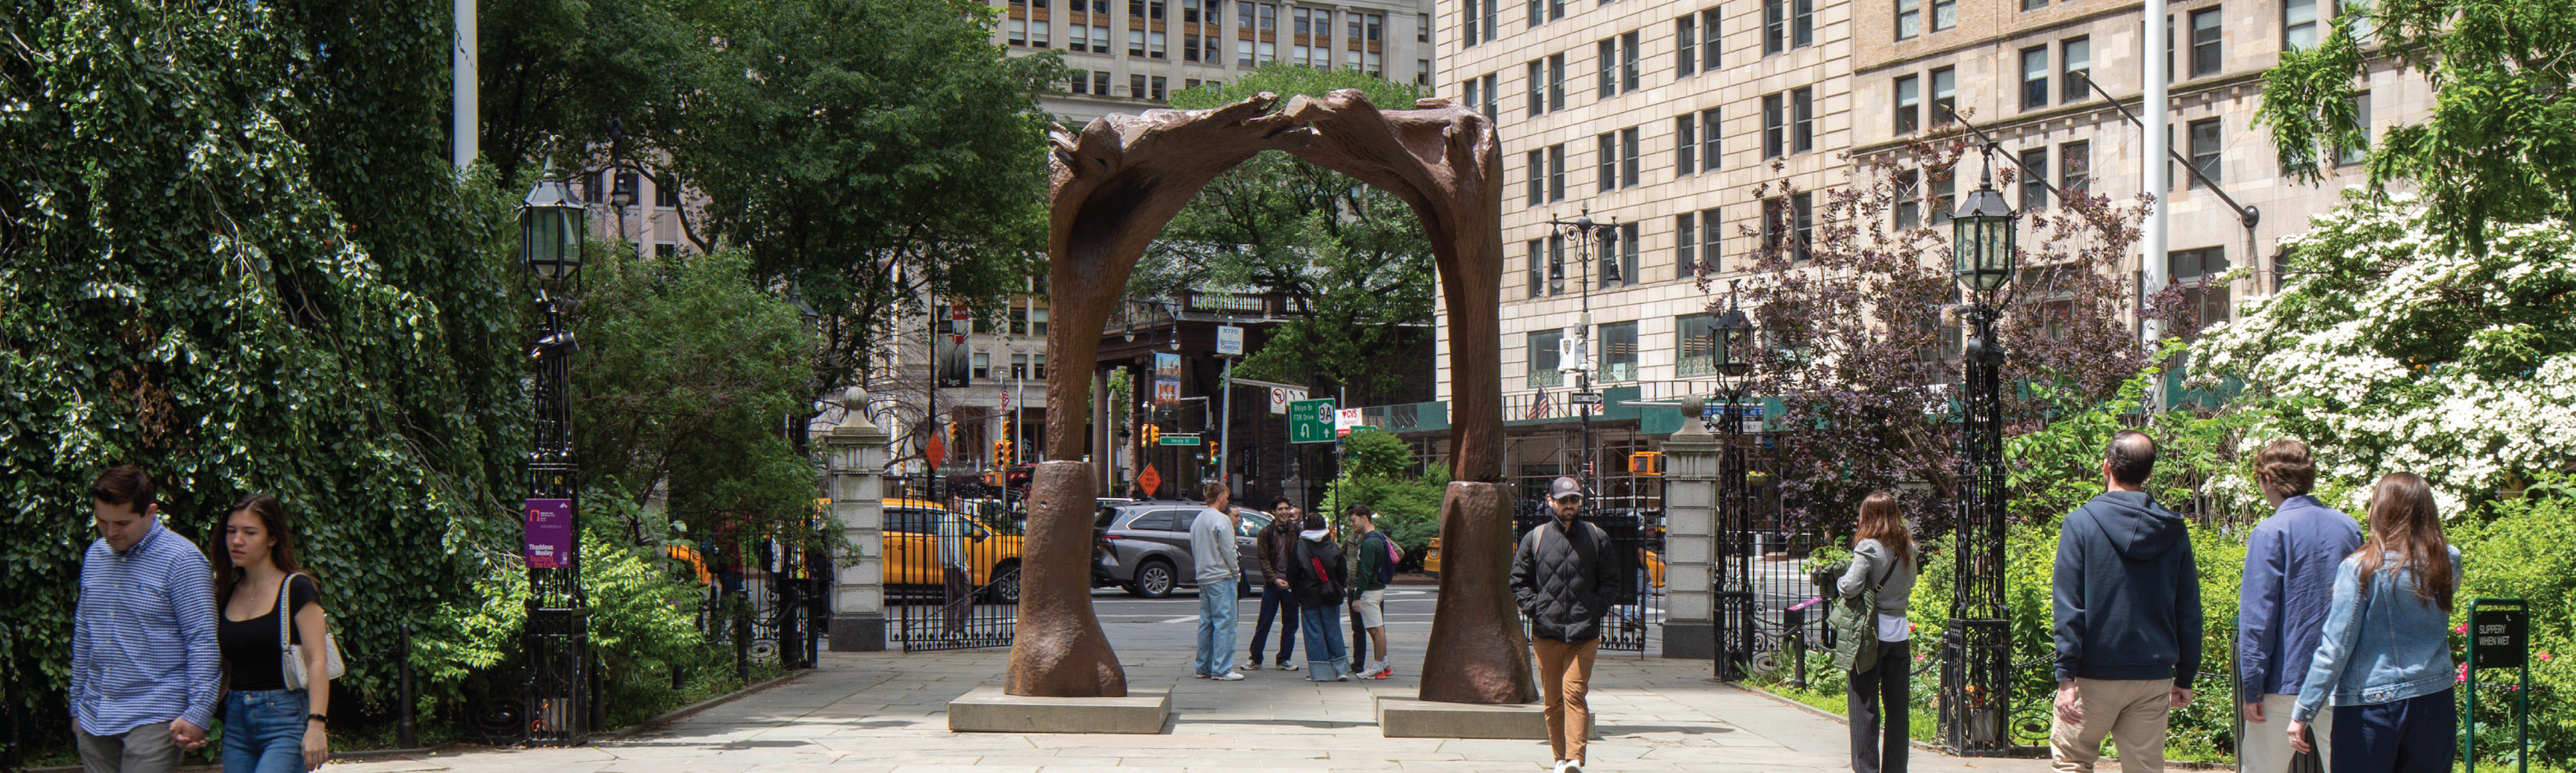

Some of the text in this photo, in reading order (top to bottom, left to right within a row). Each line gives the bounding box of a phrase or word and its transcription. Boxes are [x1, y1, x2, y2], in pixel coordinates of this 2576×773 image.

[948, 378, 960, 386] bgc
[1294, 404, 1307, 412] Bklyn
[1347, 408, 1357, 418] CVS
[1320, 407, 1332, 421] 9A
[2479, 624, 2506, 635] SLIPPERY
[2479, 635, 2510, 645] WHEN WET
